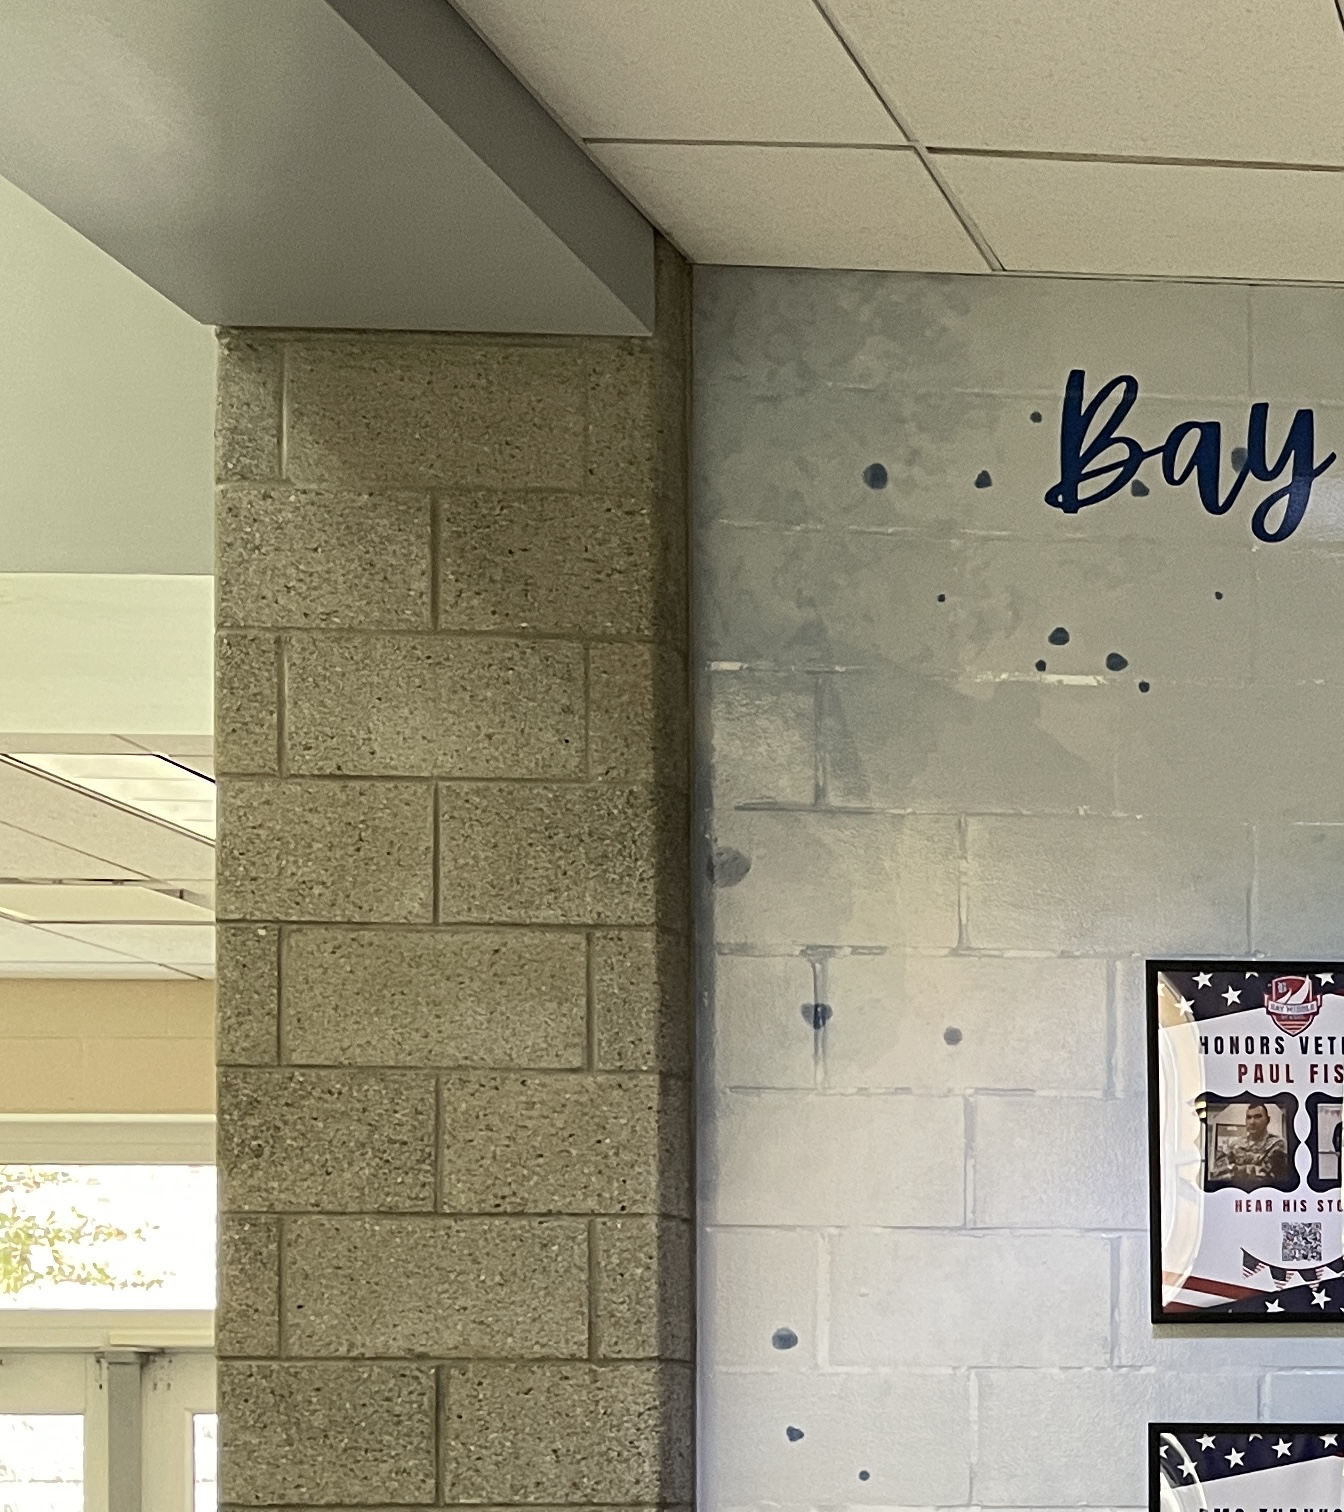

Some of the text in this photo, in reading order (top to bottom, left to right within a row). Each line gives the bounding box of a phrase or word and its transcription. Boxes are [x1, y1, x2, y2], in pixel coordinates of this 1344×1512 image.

[1045, 369, 1336, 542] Bay
[1199, 1036, 1285, 1055] HONORS
[1238, 1064, 1294, 1083] PAUL
[1235, 1200, 1272, 1212] HEAR
[1283, 1200, 1306, 1212] HIS
